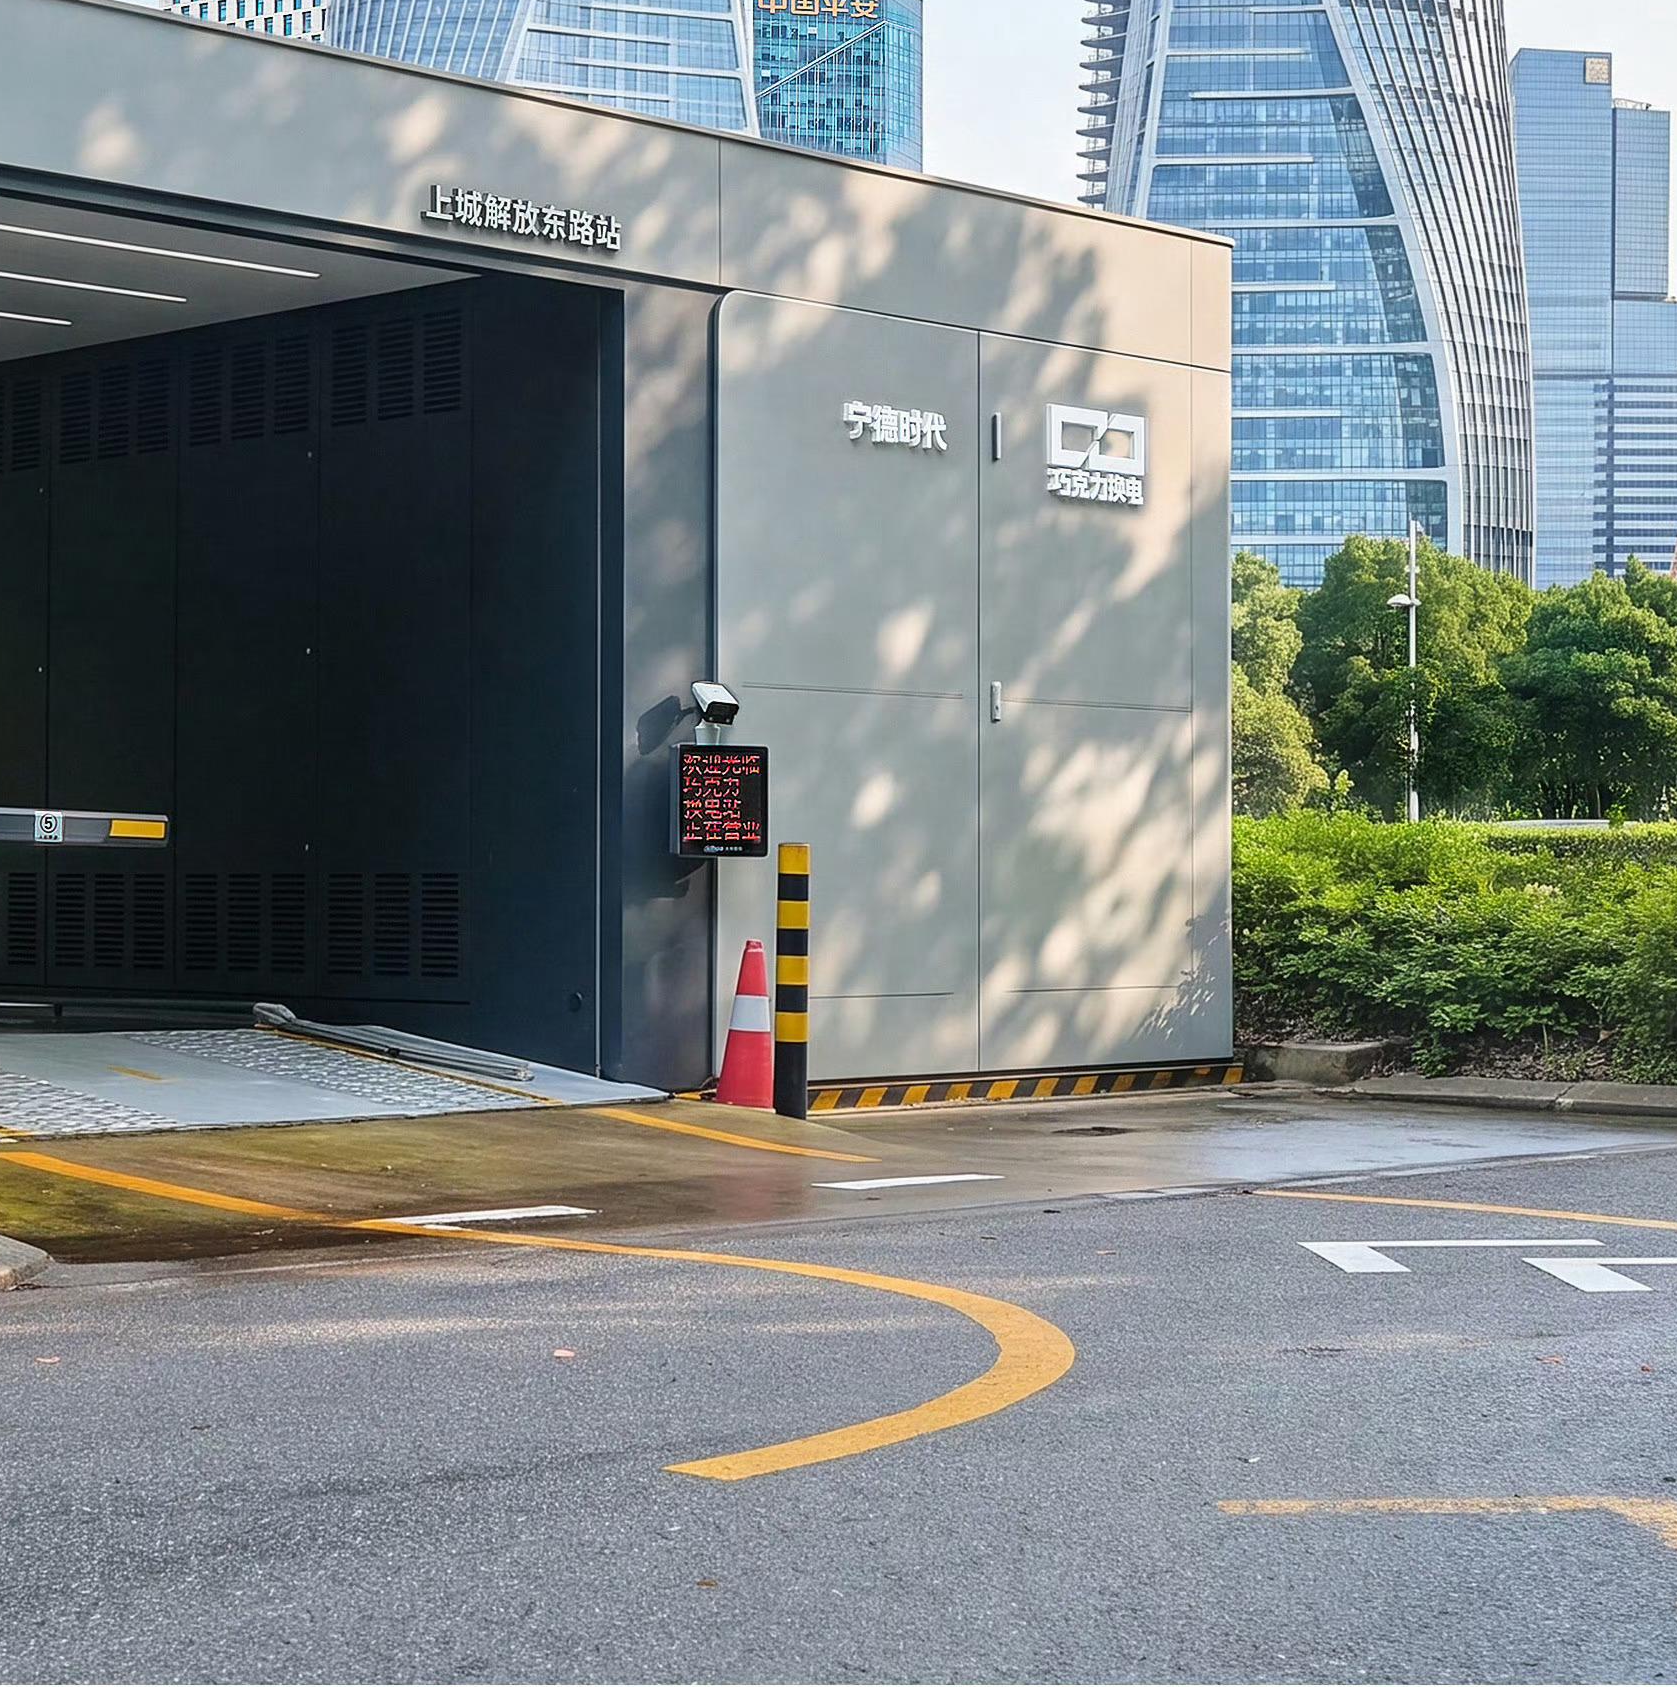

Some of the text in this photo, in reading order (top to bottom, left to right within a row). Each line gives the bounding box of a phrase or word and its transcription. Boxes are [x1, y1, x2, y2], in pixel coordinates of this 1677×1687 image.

[421, 184, 622, 251] 上城解放东路站
[843, 400, 948, 452] 宁德时代
[1046, 466, 1144, 506] 巧克力换电
[682, 754, 760, 775] 欢迎光临
